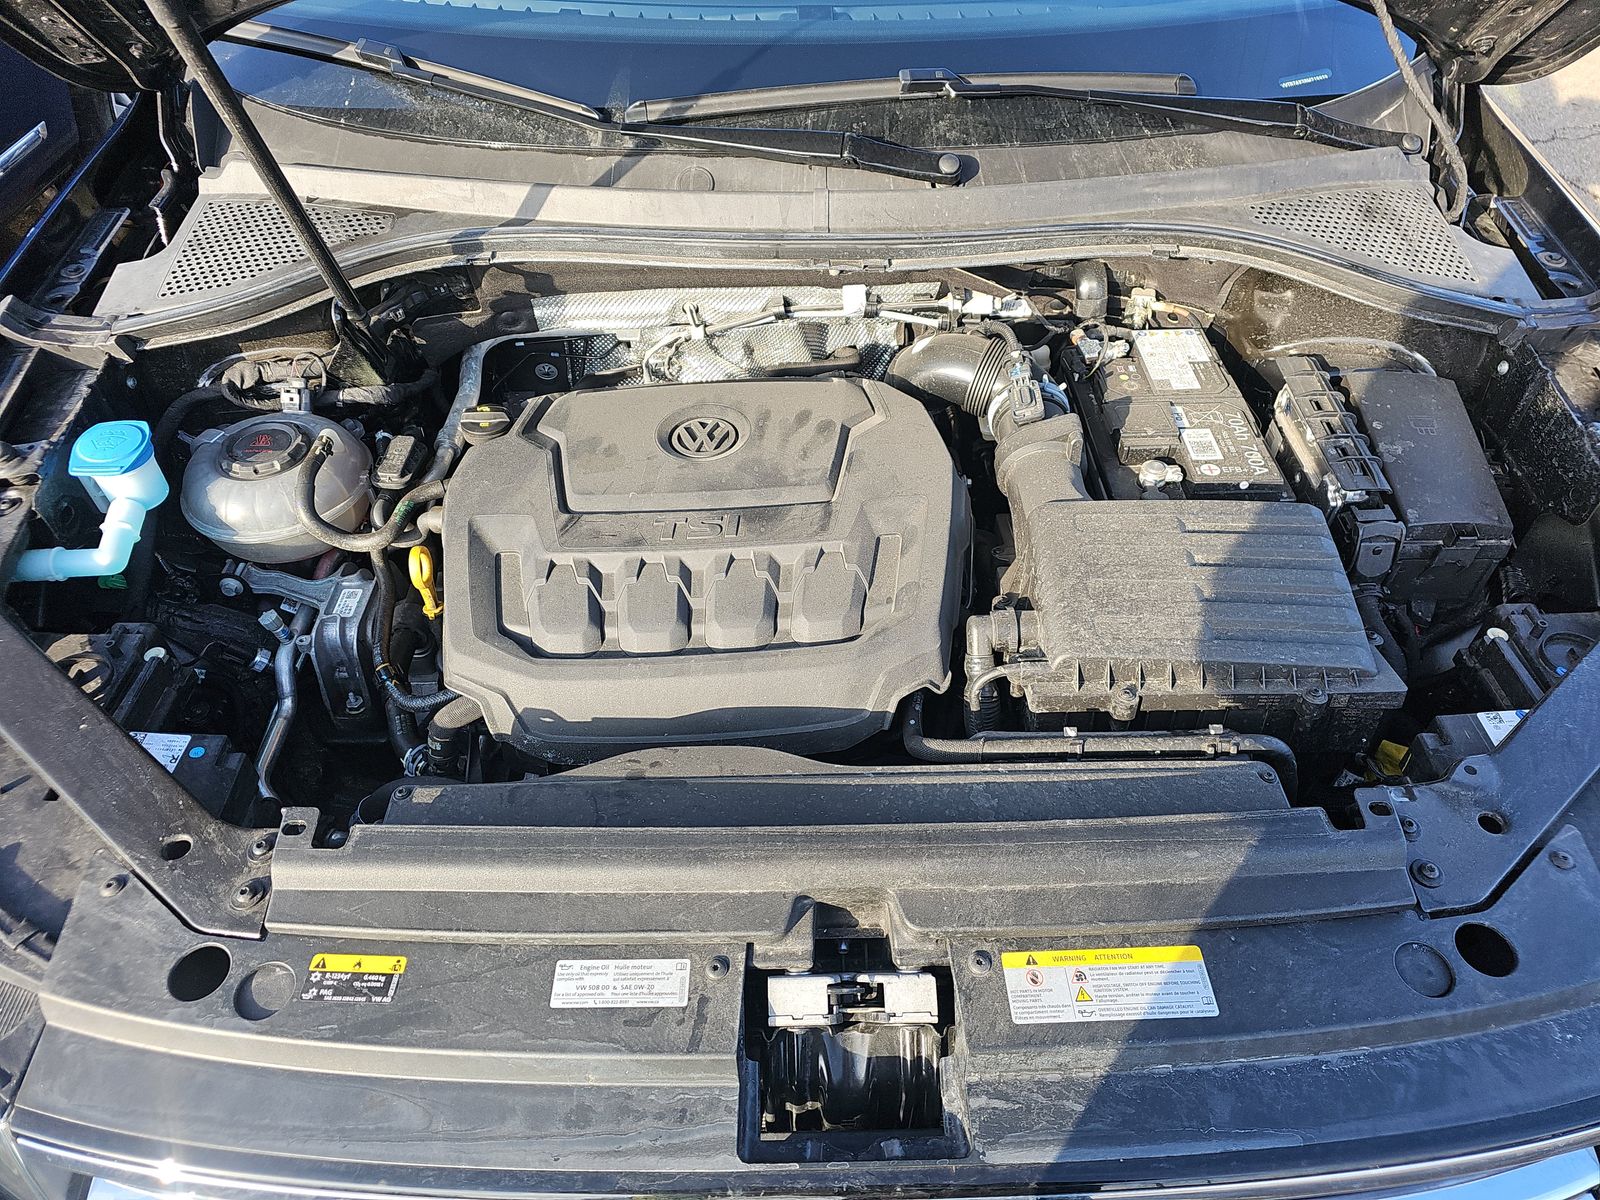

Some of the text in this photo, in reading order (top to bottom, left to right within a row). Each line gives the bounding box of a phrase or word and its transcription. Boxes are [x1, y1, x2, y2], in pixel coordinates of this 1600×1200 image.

[1225, 412, 1250, 441] 70Ah
[1240, 444, 1269, 475] 700A
[653, 514, 741, 541] TSI
[580, 964, 600, 972] Engine
[319, 988, 334, 996] PAG
